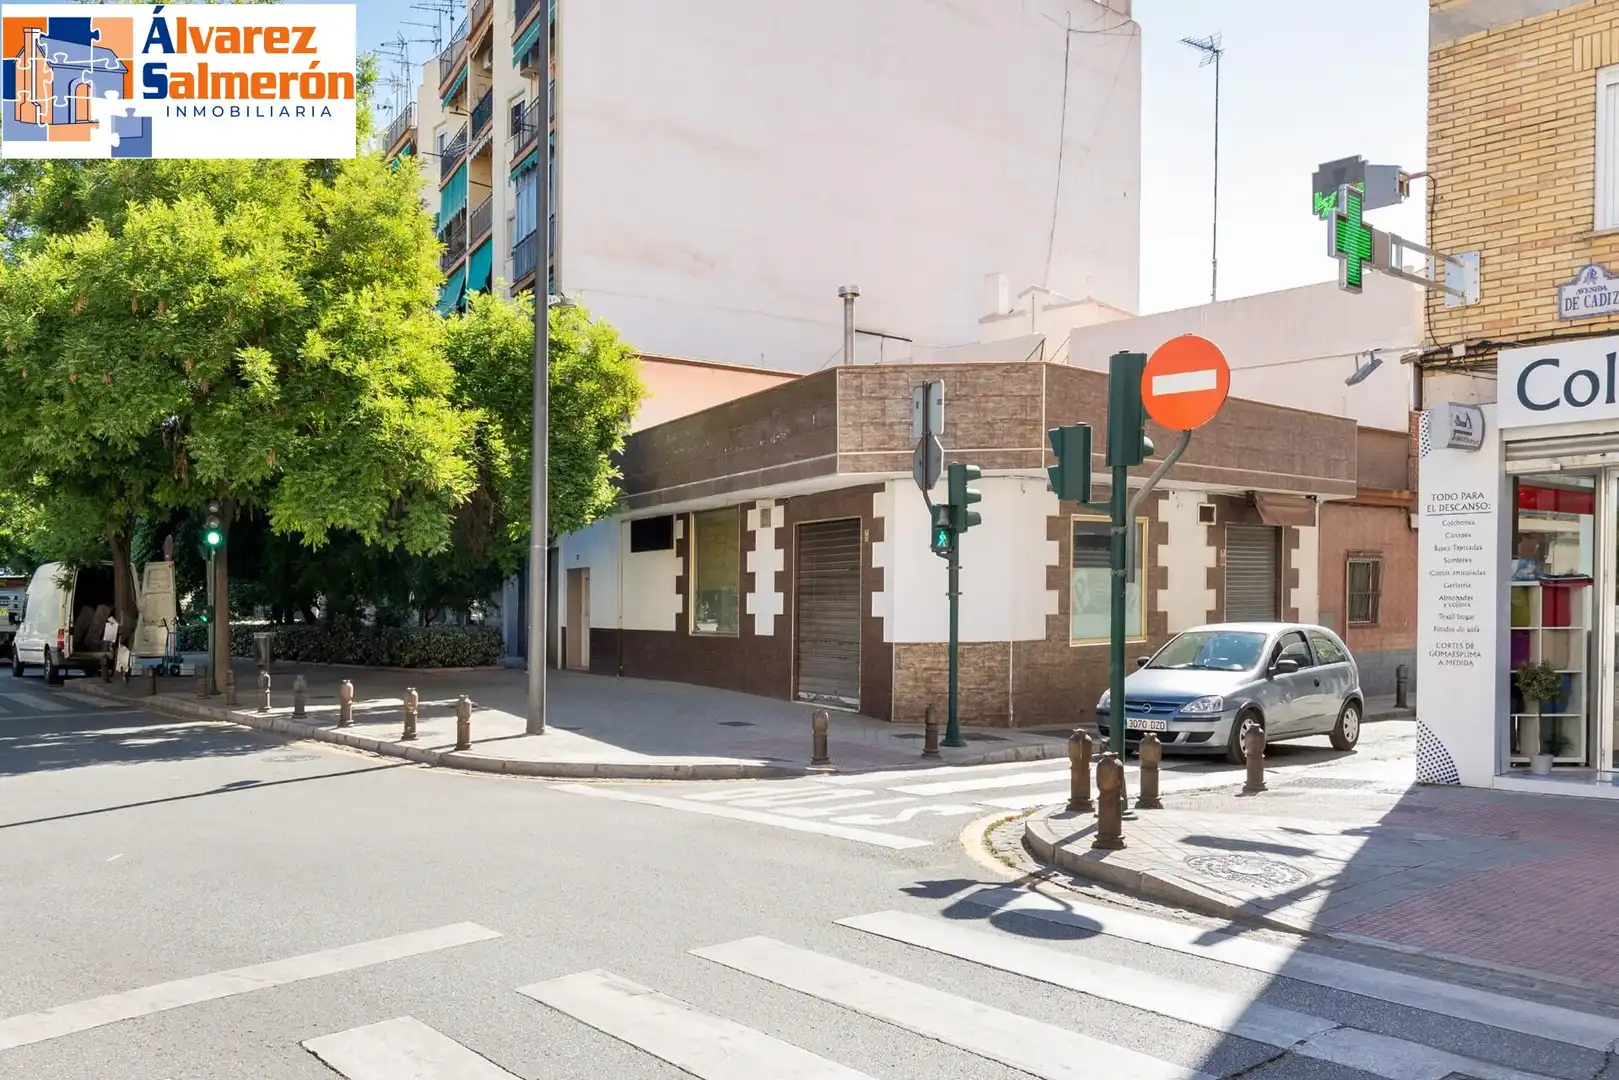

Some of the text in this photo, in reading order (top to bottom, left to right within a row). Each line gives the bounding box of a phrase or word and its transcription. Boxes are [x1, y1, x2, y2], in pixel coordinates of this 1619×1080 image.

[1576, 285, 1608, 295] AVENIDA
[1564, 296, 1580, 311] DE
[1517, 351, 1617, 411] Col
[1432, 491, 1485, 502] TODO PARA
[1426, 501, 1491, 513] EL DESCANSO:
[1465, 642, 1475, 650] DE
[1445, 659, 1474, 667] MEDIDA
[1129, 719, 1147, 729] 3070
